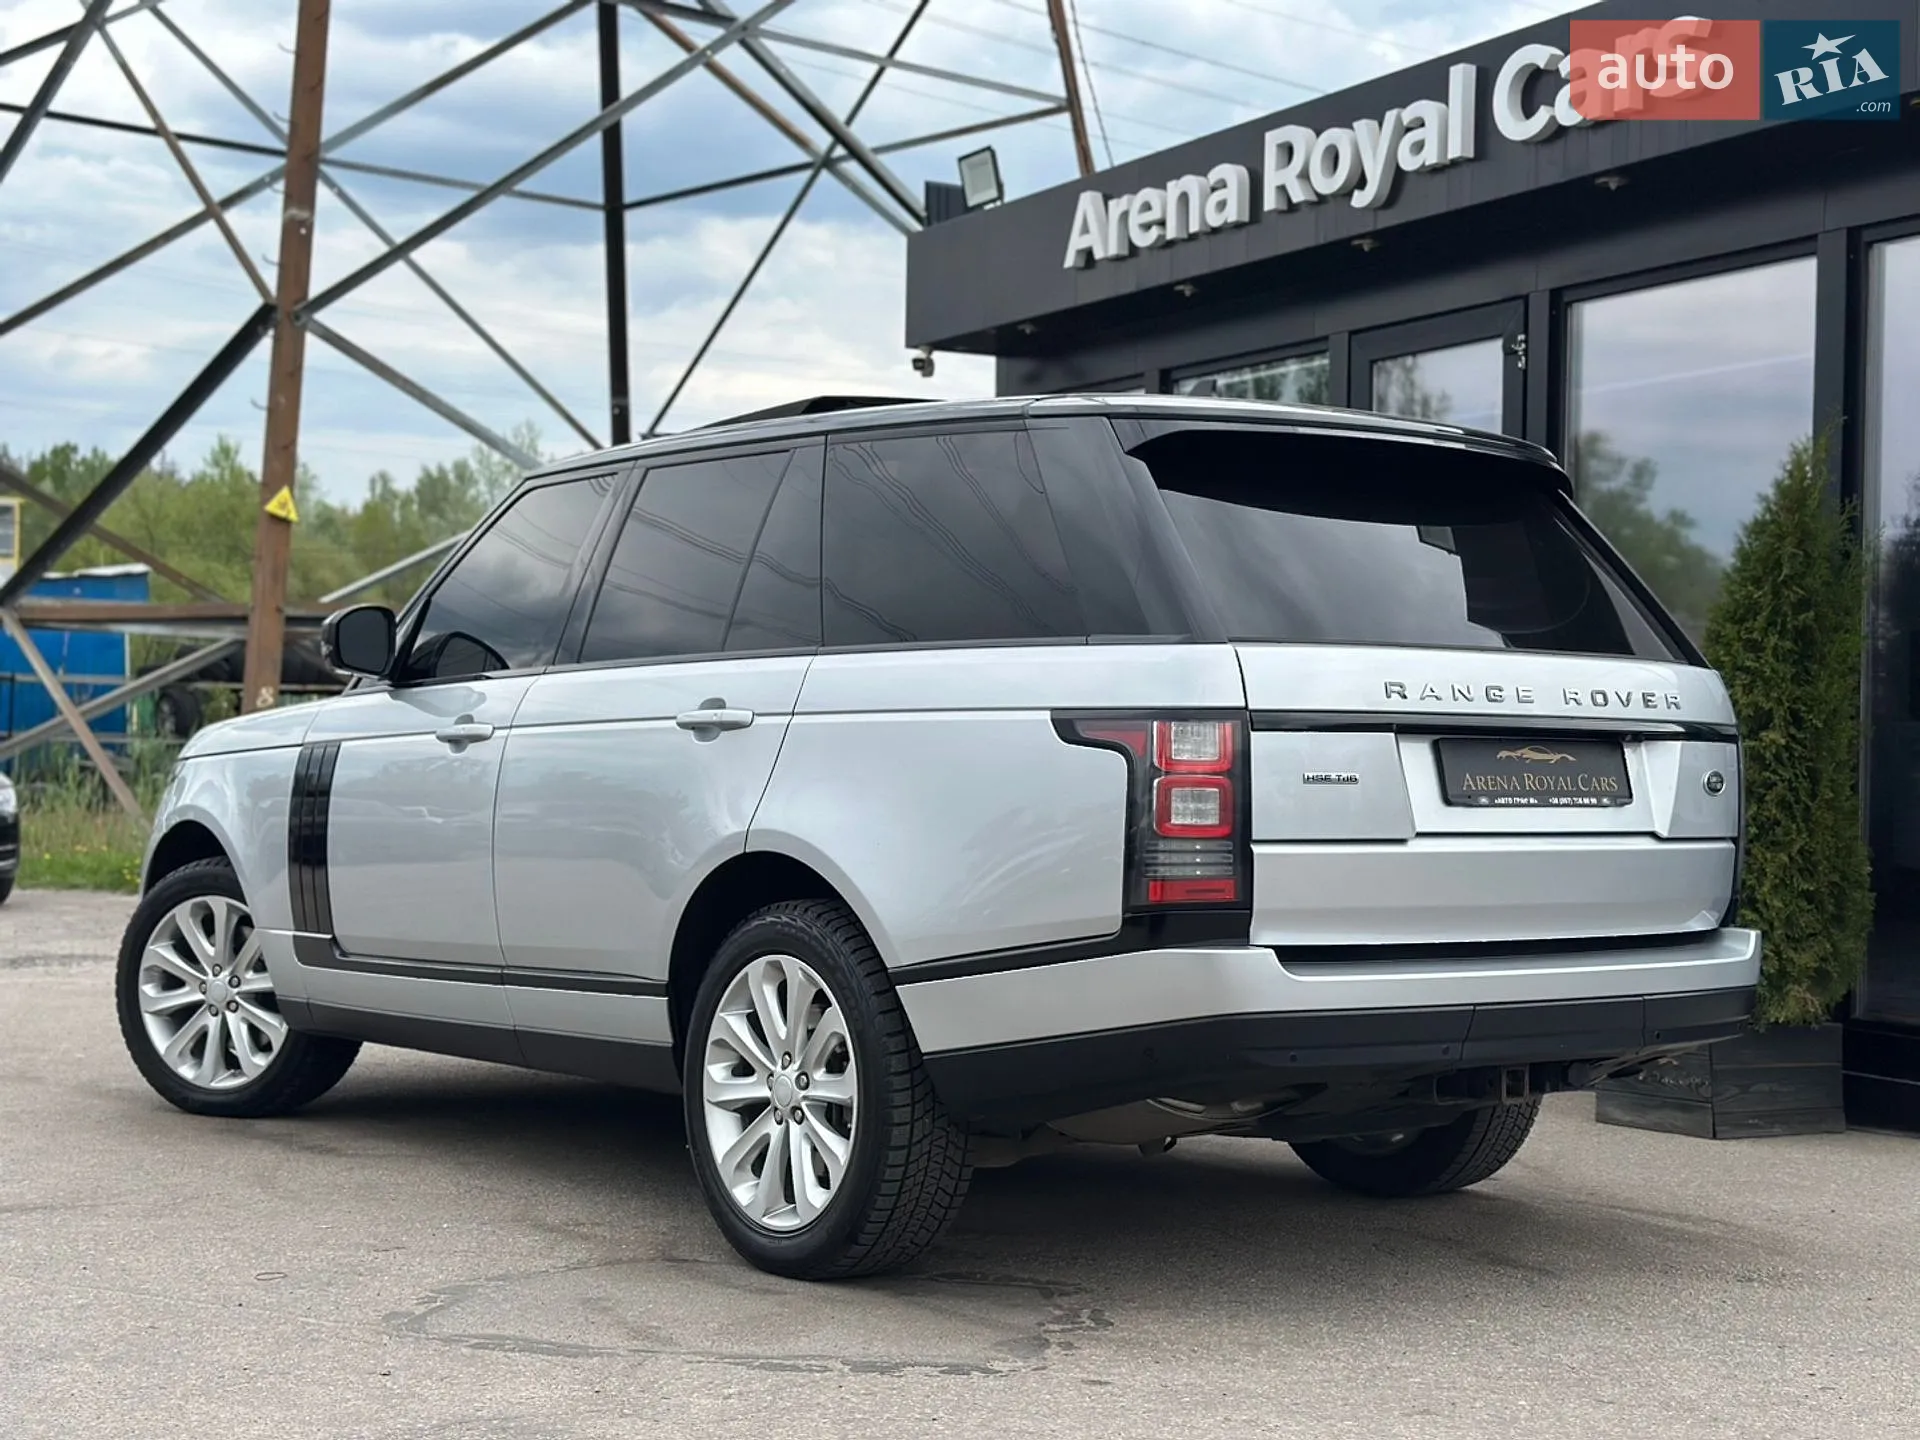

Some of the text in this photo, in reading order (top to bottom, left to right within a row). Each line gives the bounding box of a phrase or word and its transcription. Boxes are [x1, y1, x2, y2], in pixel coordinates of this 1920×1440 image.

[1063, 15, 1713, 269] Arena Royal Cars
[1384, 681, 1682, 711] RANGE ROVER
[1305, 773, 1333, 783] HSE
[1462, 772, 1619, 792] ARENA ROYAL CARS
